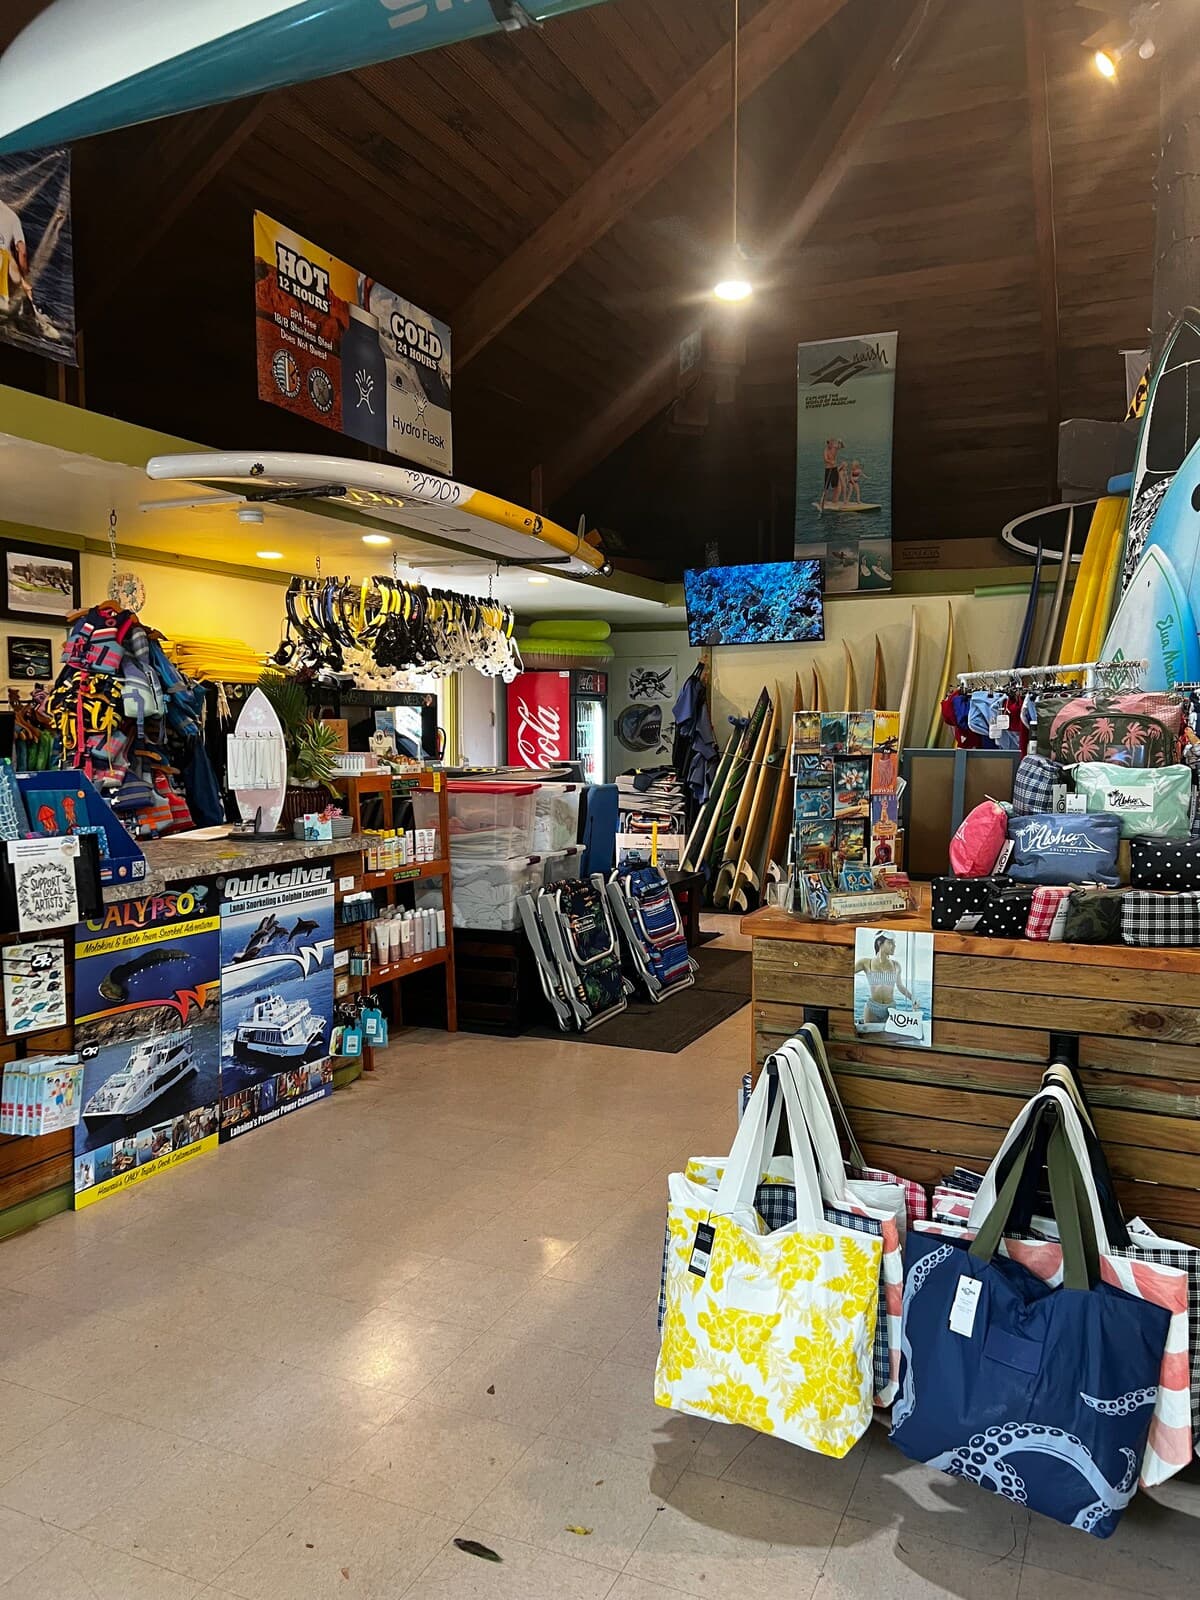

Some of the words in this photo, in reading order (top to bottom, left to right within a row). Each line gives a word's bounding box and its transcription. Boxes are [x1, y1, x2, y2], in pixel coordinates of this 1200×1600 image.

[277, 246, 328, 296] HOT
[279, 275, 290, 291] 12
[292, 283, 329, 313] HOURS
[391, 314, 442, 358] COLD
[397, 341, 408, 355] 24
[409, 347, 437, 370] HOURS
[392, 414, 421, 438] Hydro
[422, 428, 445, 449] Flask
[1028, 824, 1080, 850] Aloha
[30, 876, 61, 891] SUPPORT
[42, 887, 63, 898] LOCAL
[224, 866, 331, 898] Quicksilver
[34, 898, 64, 912] ARTISTS
[229, 902, 246, 913] Lanai
[246, 898, 277, 910] Snorkeling
[282, 891, 302, 903] Dolphin
[302, 887, 328, 898] Encounter
[84, 940, 114, 953] Molokini
[122, 935, 140, 946] Turtle
[142, 932, 158, 942] Town
[158, 927, 183, 939] Snorkel
[183, 921, 213, 933] Adventure
[889, 1013, 919, 1028] ALOHA
[230, 1118, 258, 1138] Lahaina's
[258, 1108, 281, 1125] Premier
[280, 1101, 297, 1115] Power
[297, 1088, 326, 1107] Catamaran
[124, 1171, 140, 1184] ONLY
[157, 1158, 171, 1169] Deck
[171, 1145, 202, 1163] Catamaran
